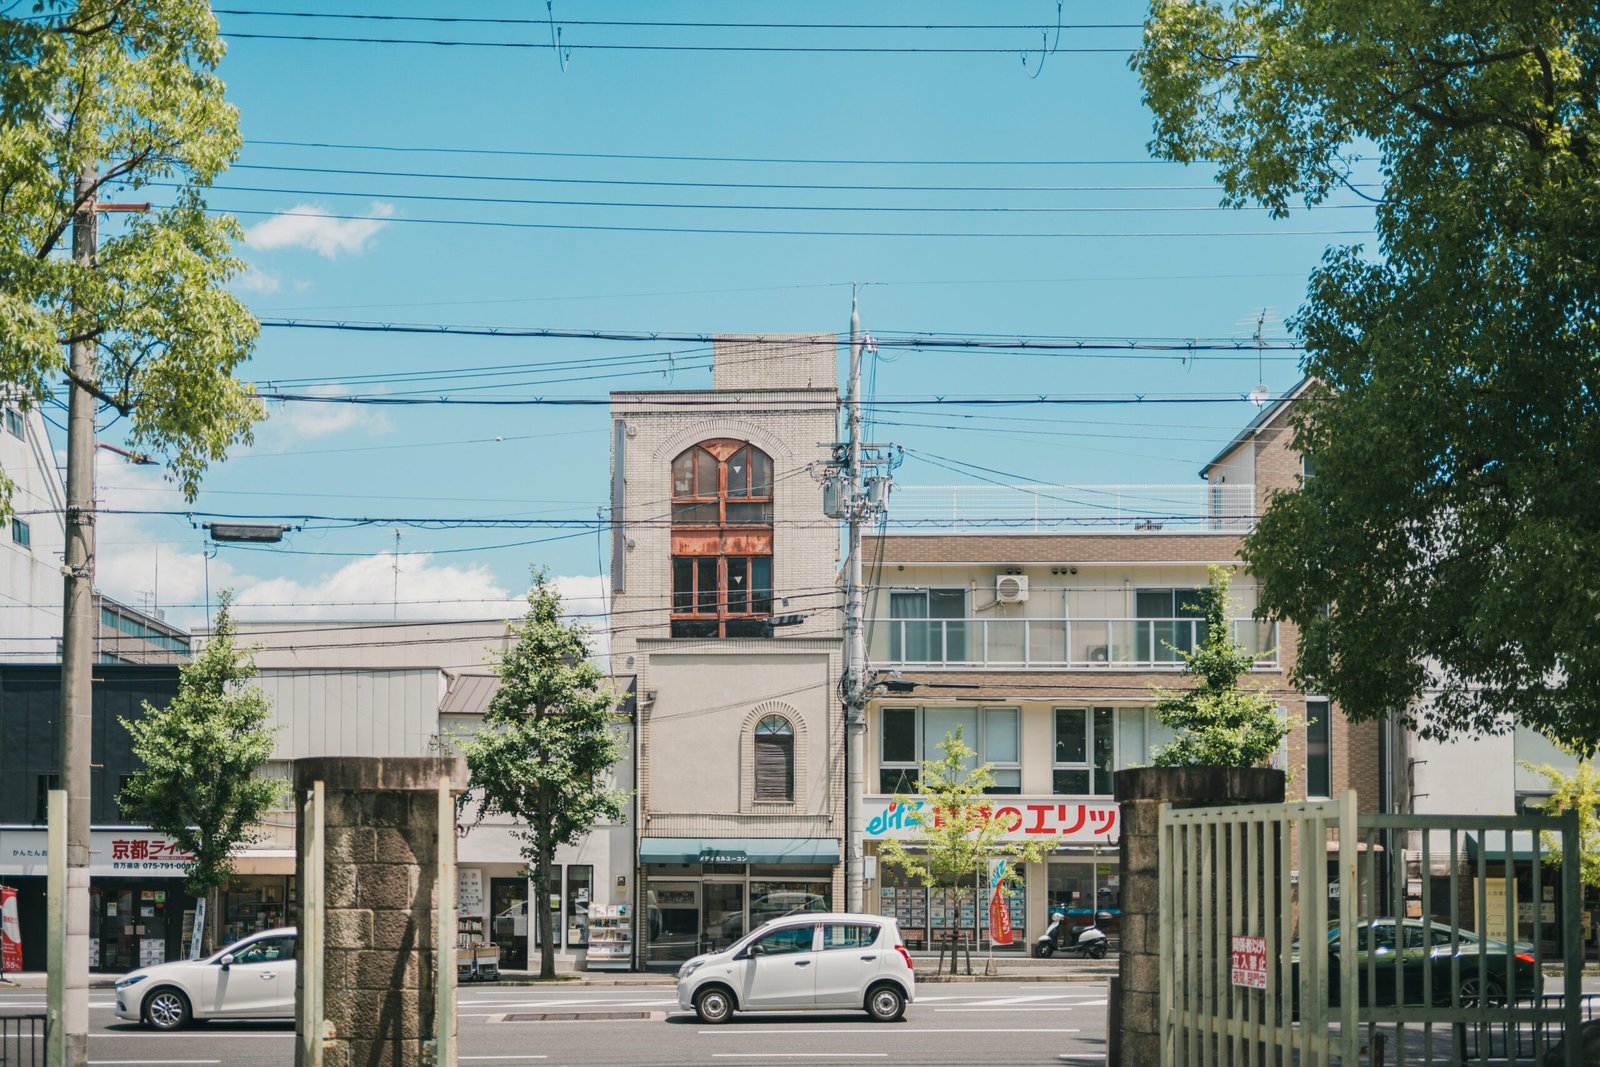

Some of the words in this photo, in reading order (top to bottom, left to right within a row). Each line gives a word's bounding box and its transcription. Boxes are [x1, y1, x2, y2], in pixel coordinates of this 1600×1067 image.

[932, 804, 1121, 836] のエリッ
[12, 849, 48, 857] かんたんお
[112, 839, 190, 860] 京都ライ
[1232, 953, 1266, 971] 立入禁止
